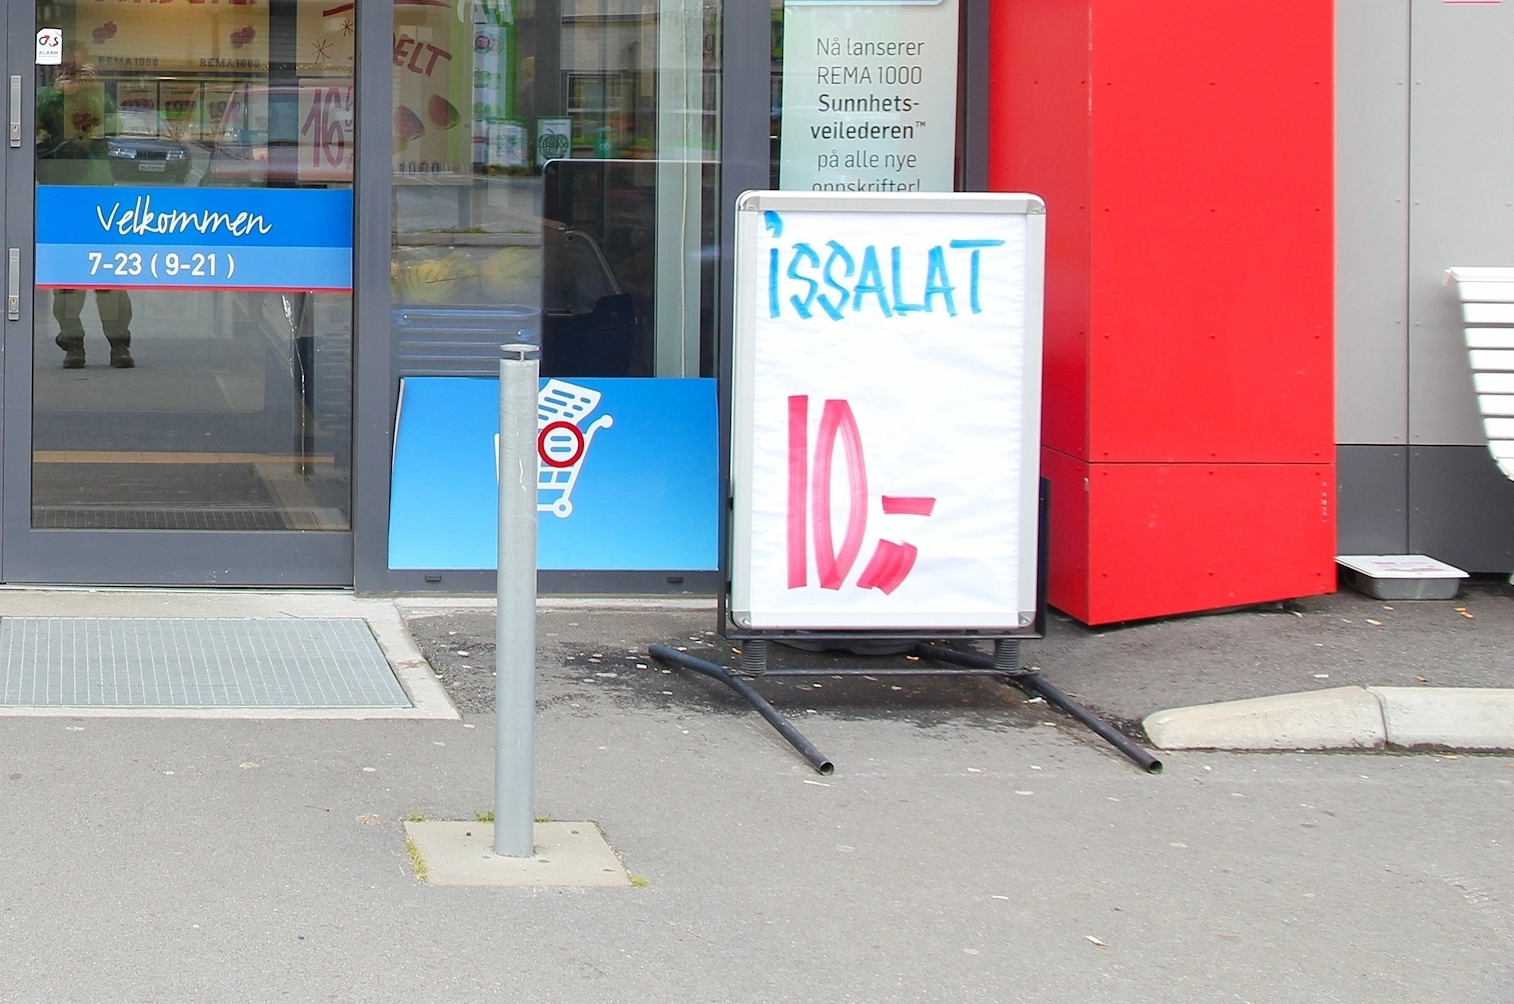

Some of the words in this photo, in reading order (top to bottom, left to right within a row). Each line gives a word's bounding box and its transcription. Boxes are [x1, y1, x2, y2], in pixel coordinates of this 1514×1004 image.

[393, 32, 453, 77] ELT
[816, 37, 841, 56] Nå
[846, 37, 925, 56] lanserer
[98, 57, 133, 66] REMA
[200, 58, 233, 68] REMA
[817, 66, 872, 85] REMA
[878, 66, 923, 85] 1000
[817, 94, 920, 112] Sunnhets-
[817, 149, 839, 172] på
[844, 150, 879, 168] alle
[885, 154, 917, 172] nye
[96, 194, 273, 236] Velkommen
[88, 252, 142, 276] 7-23
